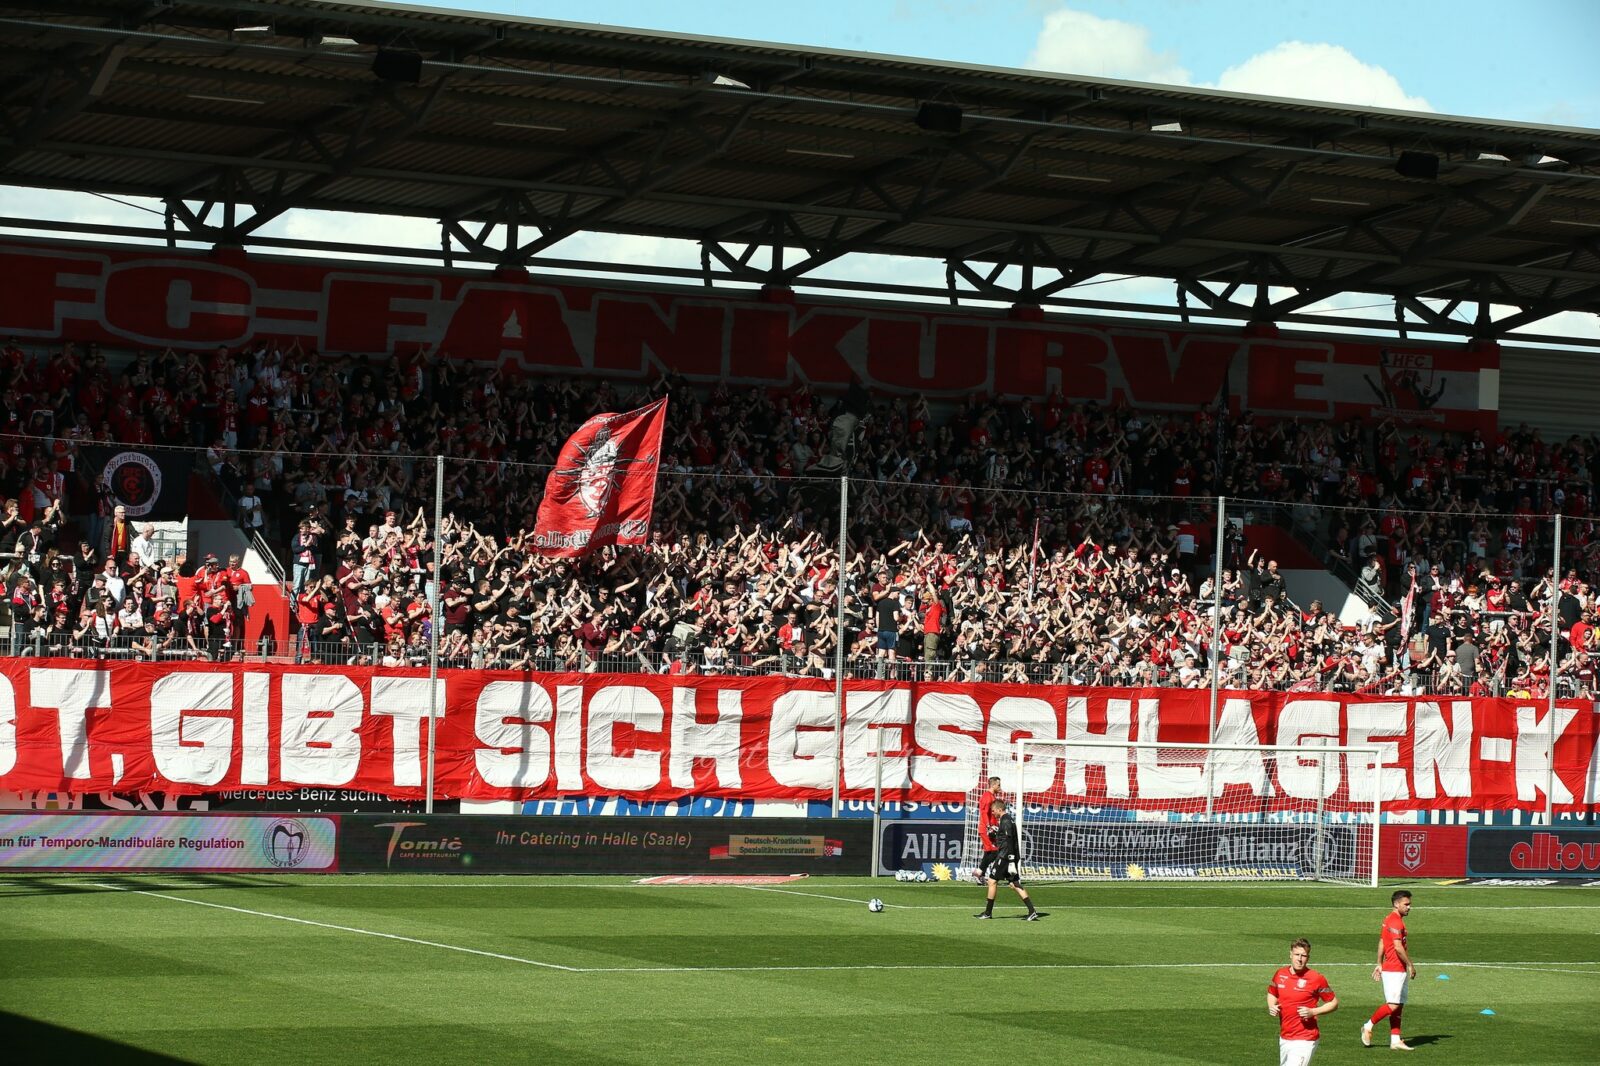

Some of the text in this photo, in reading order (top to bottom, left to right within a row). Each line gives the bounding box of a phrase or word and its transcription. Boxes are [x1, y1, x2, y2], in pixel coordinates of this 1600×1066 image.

[1393, 353, 1426, 368] HFC
[150, 671, 447, 788] GIBT
[474, 680, 743, 791] SICH
[18, 835, 36, 847] für
[39, 836, 175, 850] Temporo-Mandibuläre
[178, 837, 245, 851] Regulation
[495, 830, 692, 849] Ihr Catering in Halle (Saale)
[901, 833, 962, 860] Allia
[1064, 829, 1188, 849] Danilo Winkler
[1400, 833, 1425, 843] HFC
[1214, 834, 1299, 861] Allianz
[1020, 866, 1111, 877] IELBANK HALLE
[1147, 867, 1297, 878] MERKUR SPIELBANK HALLE
